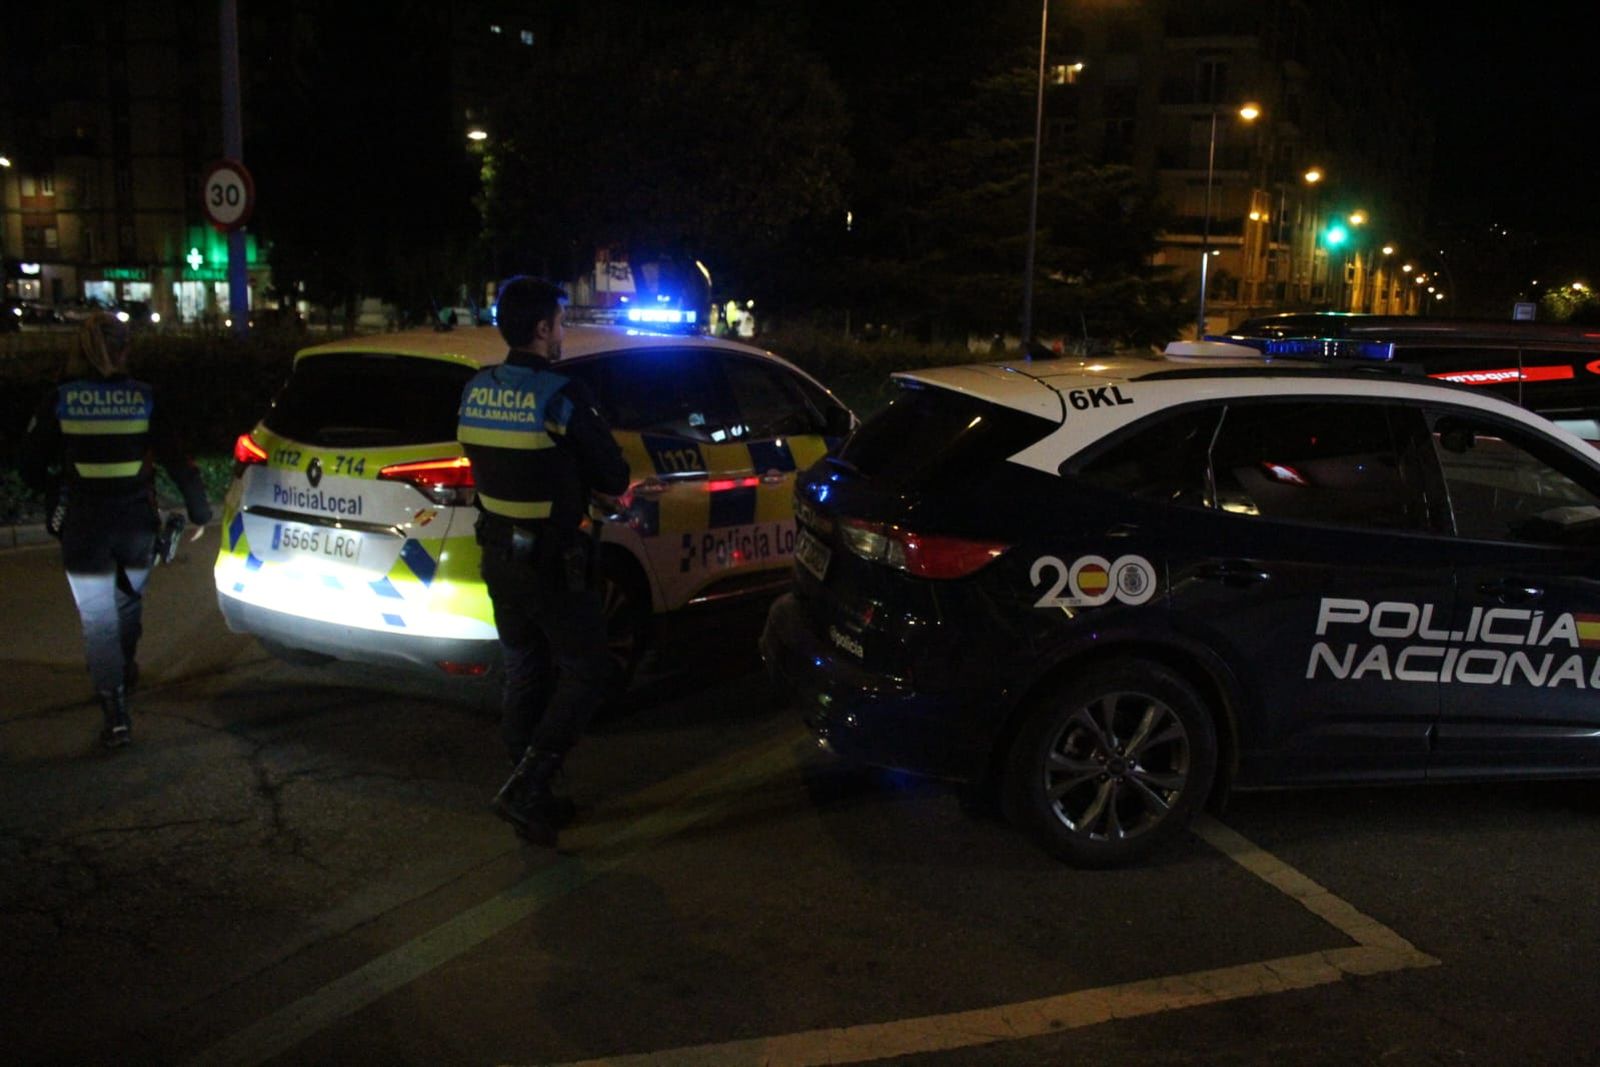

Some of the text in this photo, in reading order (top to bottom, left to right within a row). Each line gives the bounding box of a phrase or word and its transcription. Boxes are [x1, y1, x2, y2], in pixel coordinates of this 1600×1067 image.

[211, 184, 240, 207] 30
[1069, 386, 1133, 410] 6KL
[67, 405, 145, 416] SALAMANCA
[464, 406, 535, 423] SALAMANCA
[335, 455, 366, 476] 714
[283, 528, 356, 558] 5565 LRC
[1029, 554, 1157, 608] 200
[1305, 641, 1600, 689] NACIONA
